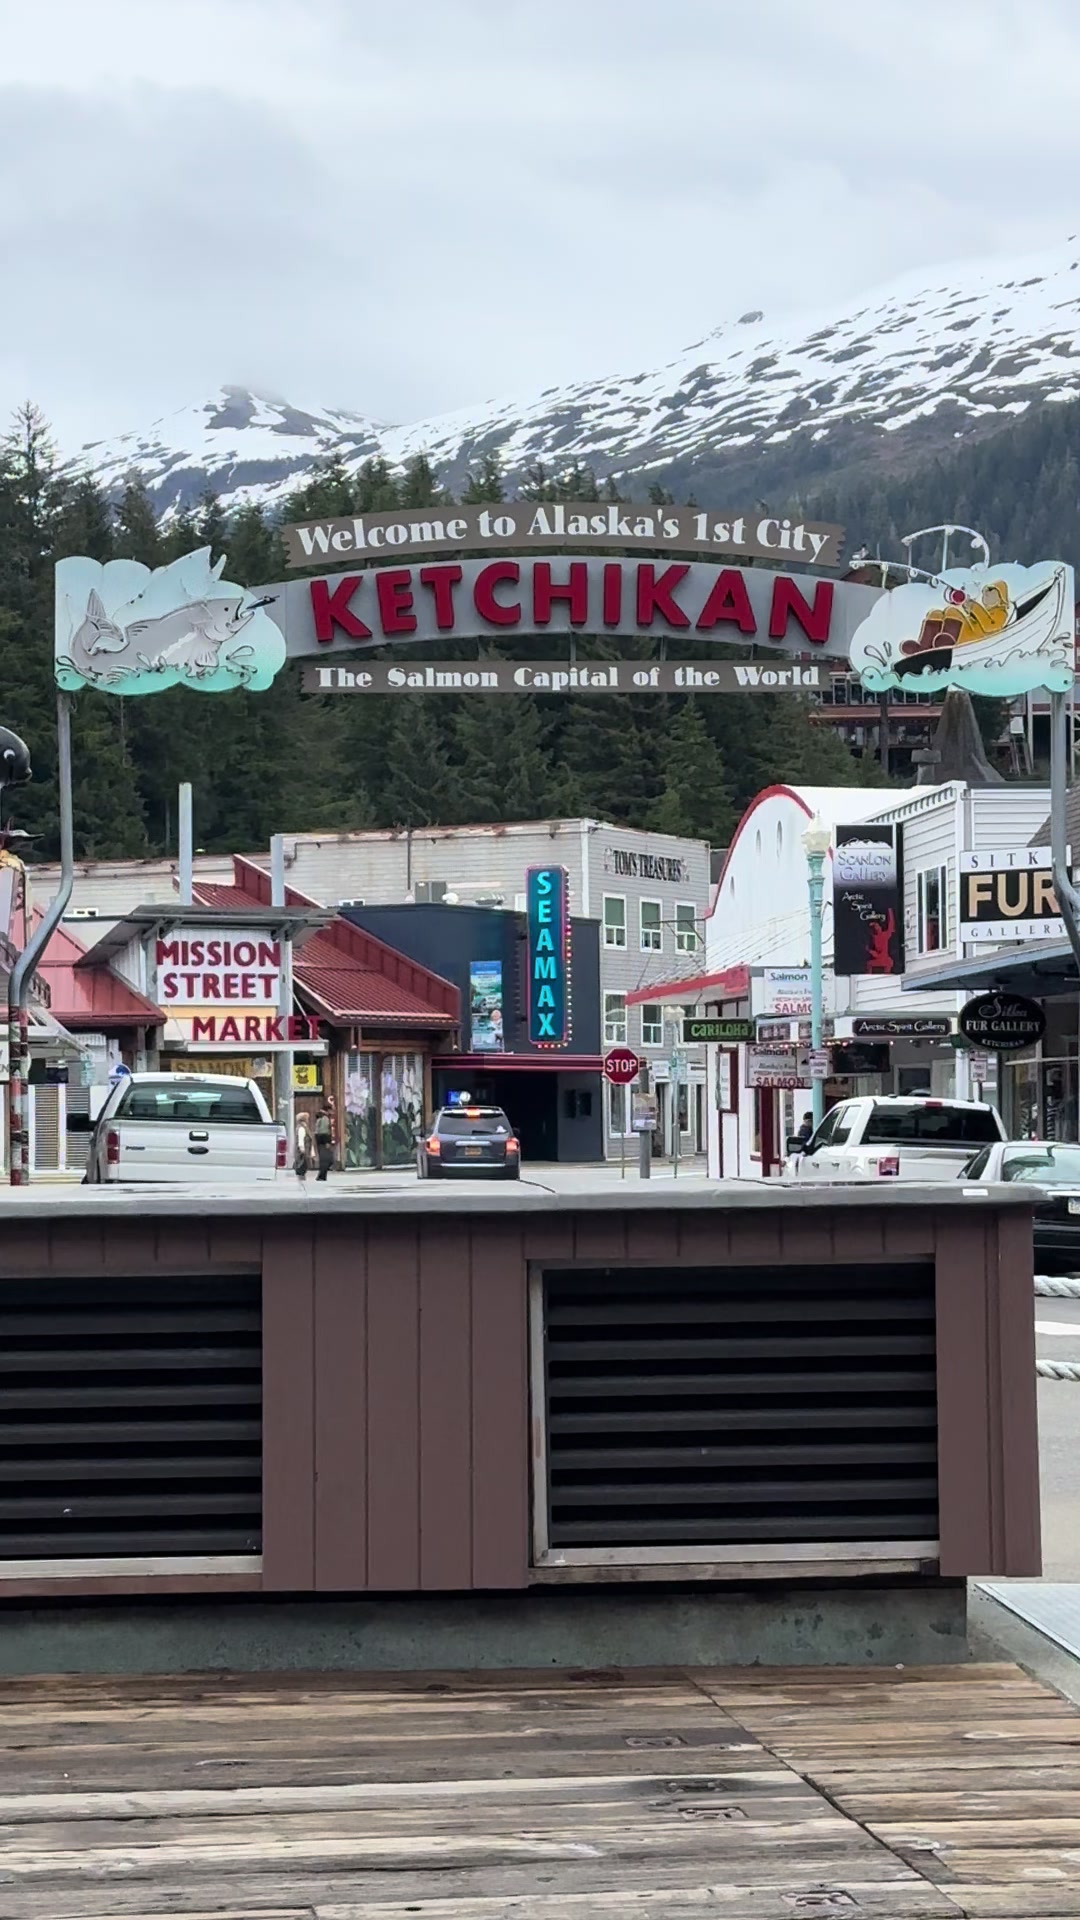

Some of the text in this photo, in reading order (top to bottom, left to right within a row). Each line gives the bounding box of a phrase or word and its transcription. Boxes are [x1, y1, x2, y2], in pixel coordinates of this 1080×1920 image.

[296, 505, 830, 563] Welcome to Alaska's 1st City
[309, 561, 833, 644] KETCHIKAN
[315, 666, 819, 691] The Salmon Capital of the World
[638, 854, 681, 882] TREASURES
[971, 851, 1038, 869] SITK
[842, 892, 864, 901] Arctic
[968, 871, 1062, 917] FUR
[851, 901, 872, 912] Spirit
[860, 910, 886, 921] Gallery
[971, 924, 1064, 938] GALLERY
[156, 940, 280, 967] MISSION
[534, 871, 557, 1036] SEAMAX
[163, 973, 278, 998] STREET
[770, 972, 808, 981] Salmon
[192, 1016, 321, 1041] MARKET
[859, 1020, 945, 1033] Arctic Spirit Gallery
[966, 1020, 1040, 1032] FUR GALLERY
[606, 1059, 637, 1073] STOP
[755, 1076, 805, 1088] SALMON
